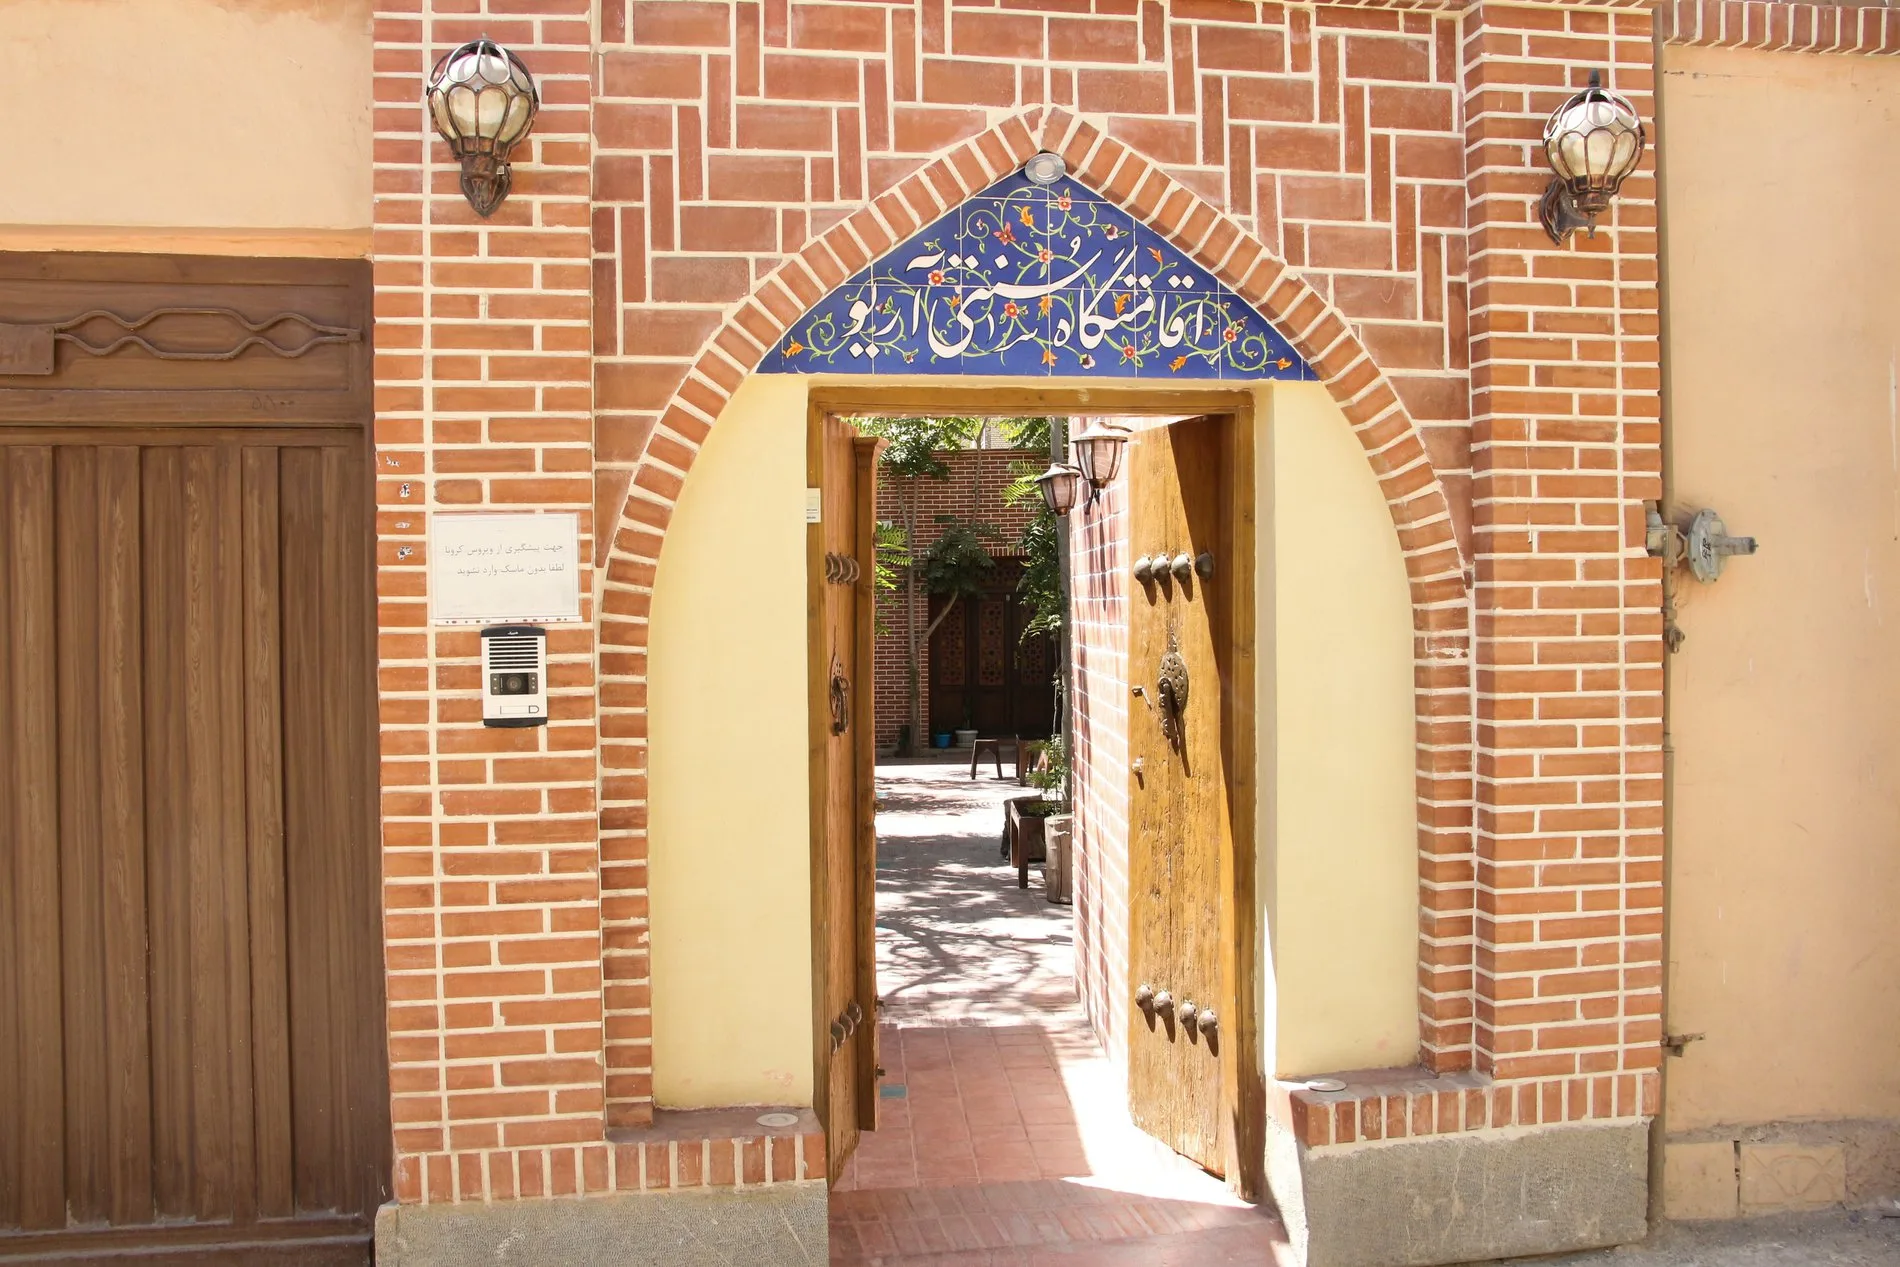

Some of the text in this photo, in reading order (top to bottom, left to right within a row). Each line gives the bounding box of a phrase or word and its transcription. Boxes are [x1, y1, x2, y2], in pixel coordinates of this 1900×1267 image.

[445, 544, 465, 557] کرونا
[467, 546, 494, 556] ویروس
[496, 544, 503, 555] از
[543, 544, 563, 553] جهت
[457, 562, 565, 577] لطفا بدون ماسک وارد نشوید
